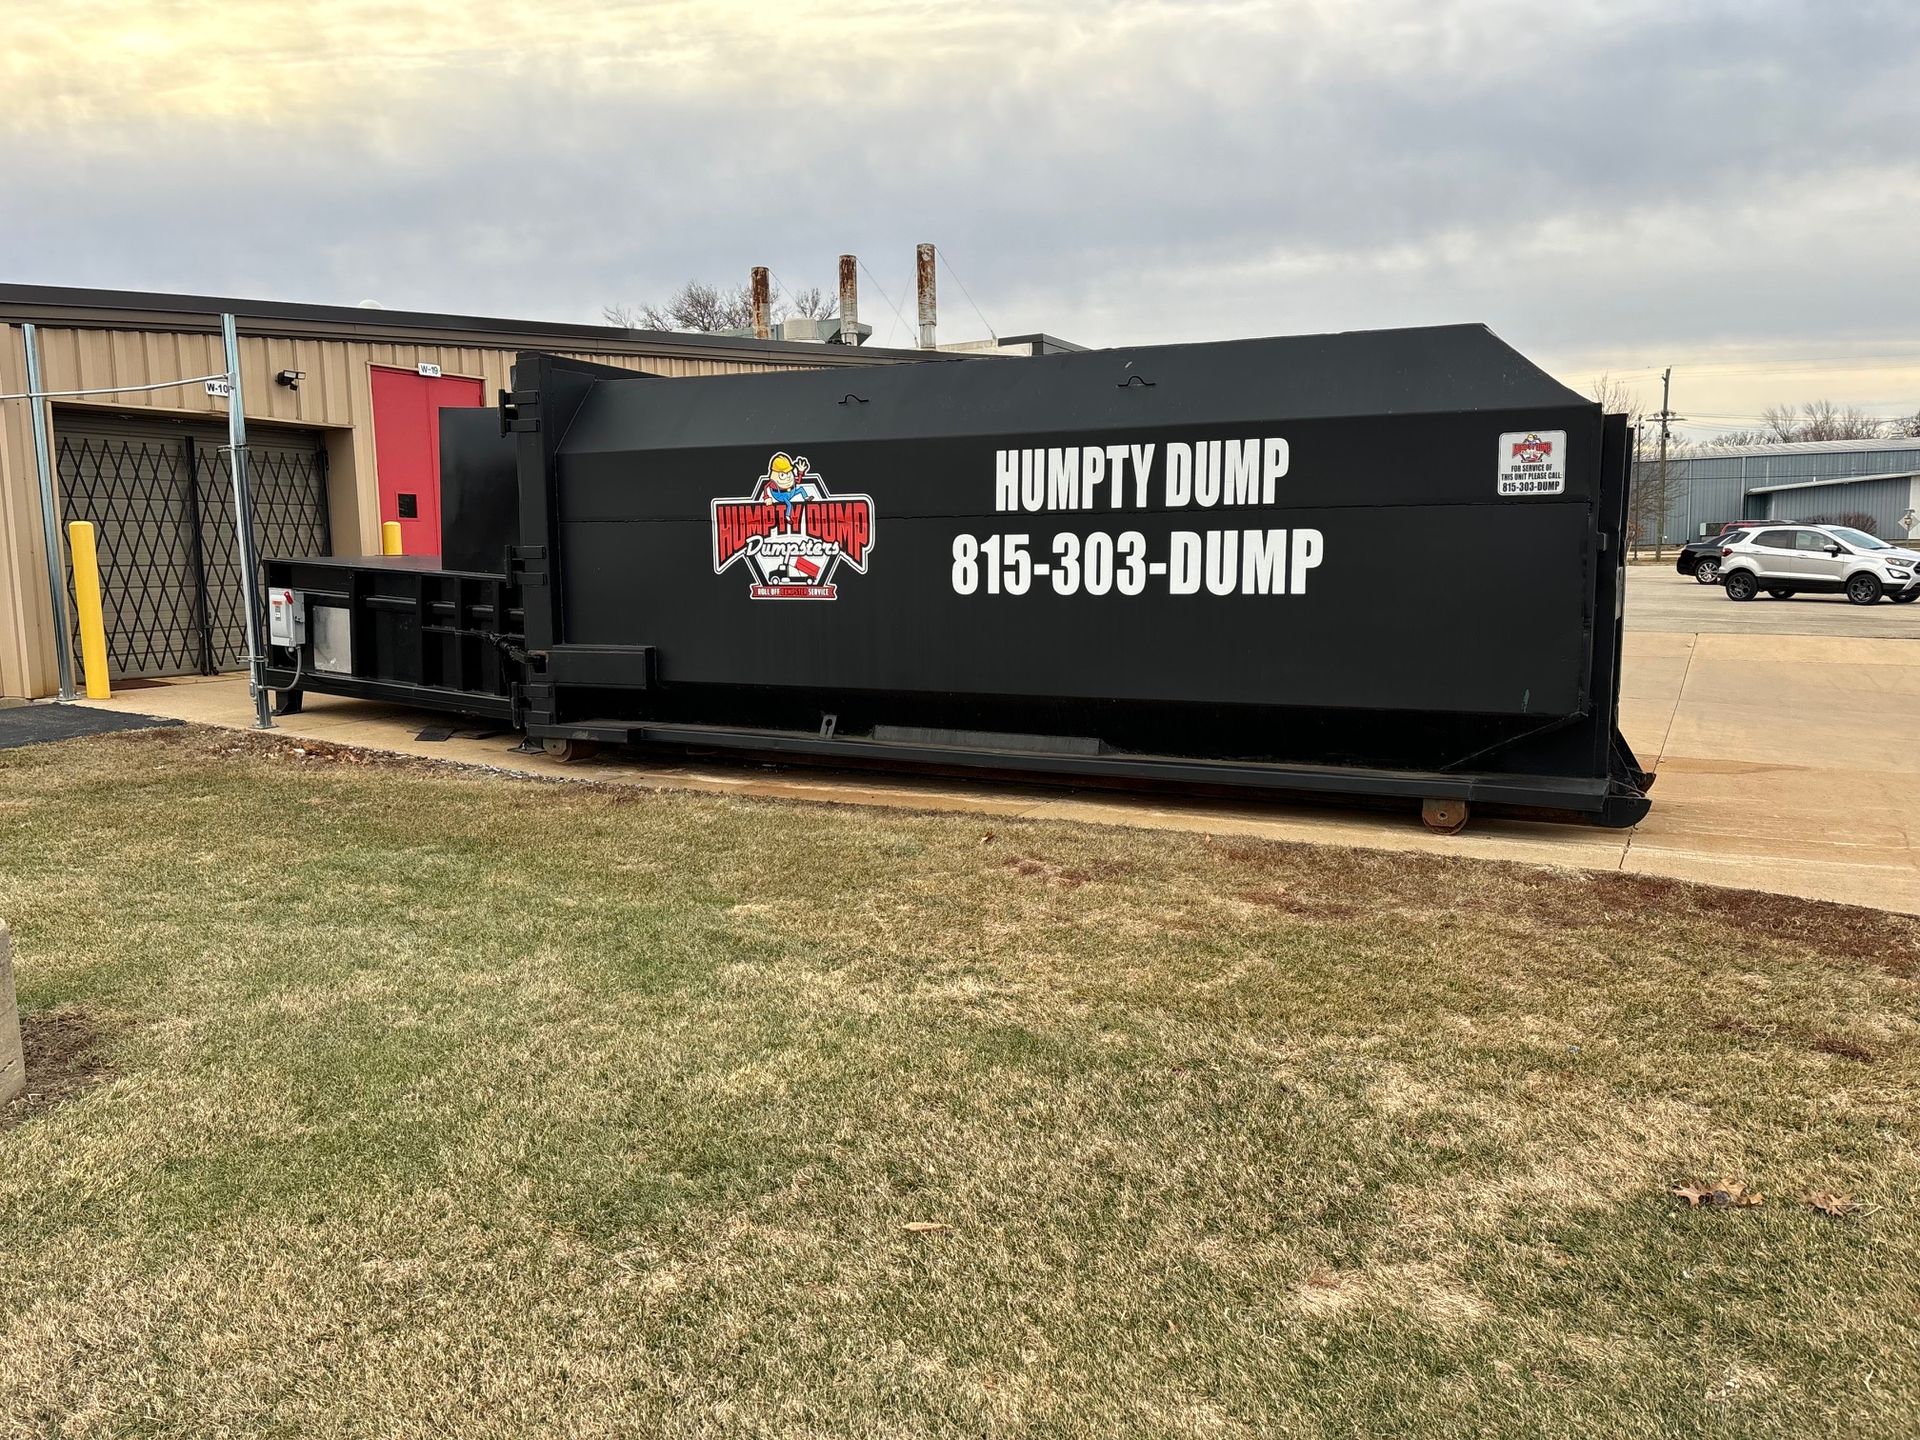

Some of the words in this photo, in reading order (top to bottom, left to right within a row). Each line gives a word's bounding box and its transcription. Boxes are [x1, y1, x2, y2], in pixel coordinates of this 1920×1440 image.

[420, 364, 439, 375] W-19
[206, 382, 229, 394] W-10
[1522, 464, 1544, 472] SERVICE
[996, 443, 1156, 512] HUMPTY
[1165, 437, 1290, 507] DUMP
[1528, 472, 1547, 480] PLEASE
[1502, 481, 1560, 492] 815-303-DUMP
[717, 503, 803, 562] HUMPTY
[806, 502, 869, 563] DUMP
[746, 535, 840, 564] Dumpsters
[951, 528, 1324, 596] 815-303-DUMP
[757, 588, 770, 596] ROLL
[808, 588, 829, 596] SERVICE
